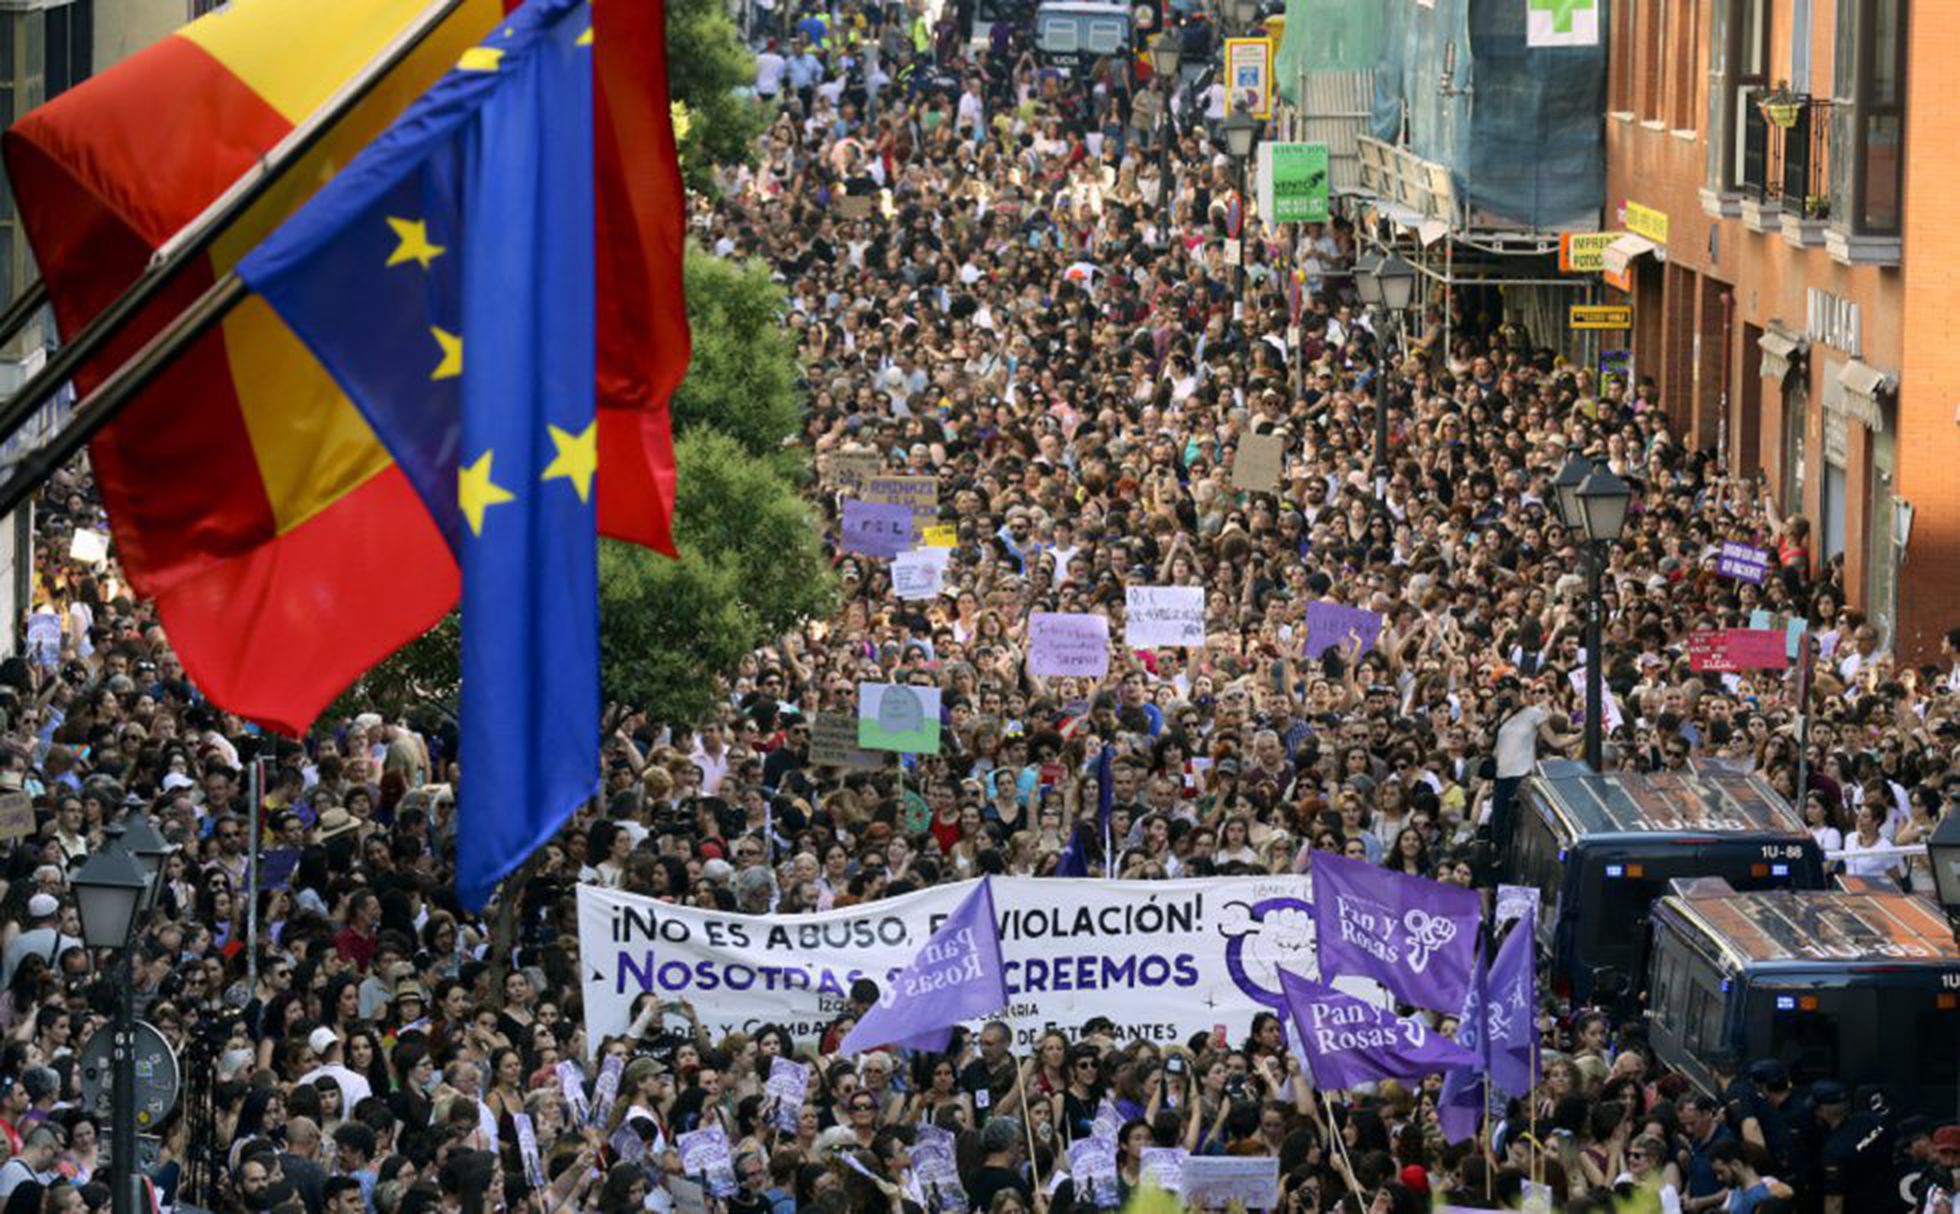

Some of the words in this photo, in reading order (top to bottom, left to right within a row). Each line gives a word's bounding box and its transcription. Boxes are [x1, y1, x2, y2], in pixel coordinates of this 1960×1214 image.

[1336, 895, 1375, 933] Pan
[704, 920, 750, 949] ES
[766, 915, 913, 951] ABUSO,
[1340, 918, 1399, 963] Rosas
[1002, 953, 1199, 996] CREEMOS
[1310, 1002, 1365, 1029] Pan
[1314, 1026, 1398, 1055] Rosas
